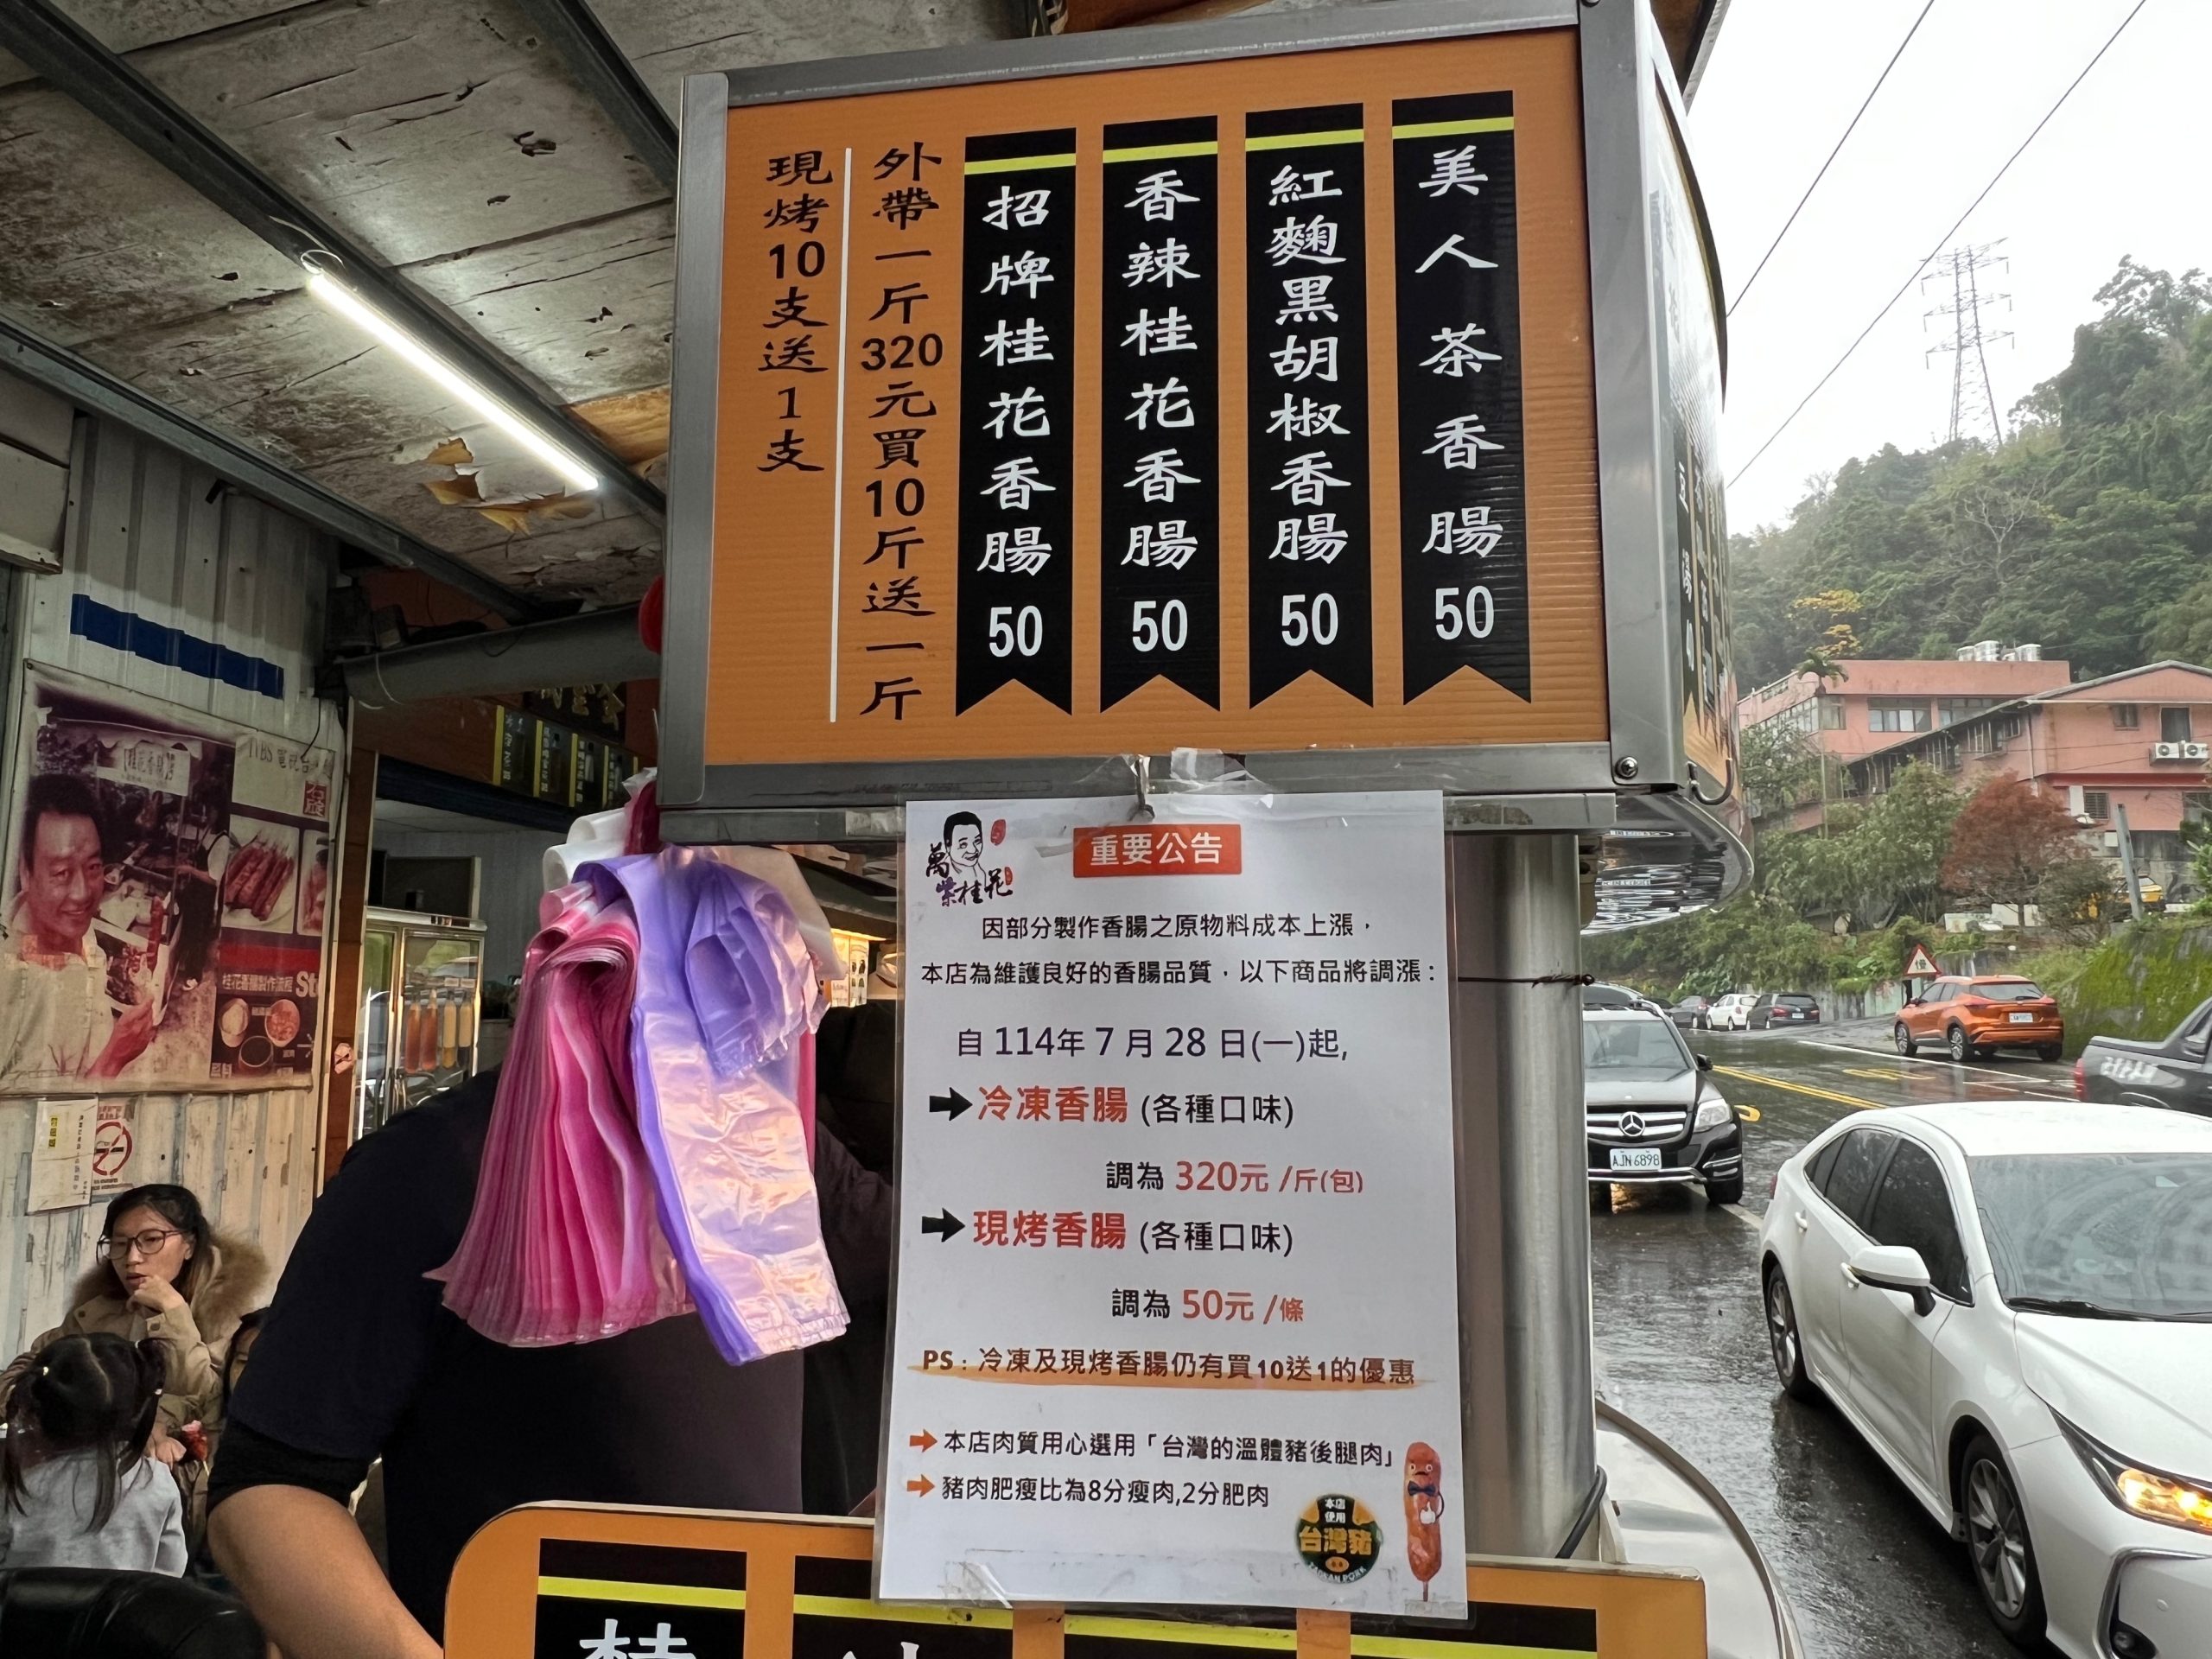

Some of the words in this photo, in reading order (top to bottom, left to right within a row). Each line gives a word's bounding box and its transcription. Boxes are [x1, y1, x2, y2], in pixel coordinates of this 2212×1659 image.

[757, 150, 834, 472] 現烤10支送1支
[1120, 169, 1201, 570] 香辣桂花香腸
[1265, 165, 1351, 564] 紅麴黑胡椒香腸
[1414, 144, 1505, 557] 美人茶香腸
[976, 185, 1056, 576] 招牌桂花香腸
[859, 142, 944, 721] 外帶一斤320元買10斤送一斤
[988, 606, 1044, 658] 50
[1132, 599, 1188, 652] 50
[1281, 593, 1338, 646] 50
[1435, 585, 1495, 640] 50
[1090, 831, 1223, 866] 重要公告
[957, 1028, 983, 1057] 自
[995, 1027, 1085, 1057] 114年
[1096, 1027, 1114, 1056] 7
[1126, 1029, 1153, 1058] 月
[1165, 1027, 1206, 1057] 28
[977, 1085, 1128, 1123] 冷凍香腸
[1141, 1094, 1294, 1128] (各種口味)
[1105, 1160, 1164, 1191] 調為
[1174, 1160, 1269, 1192] 320元
[972, 1210, 1126, 1249] 現烤香腸
[1139, 1221, 1294, 1257] (各種口味)
[1111, 1288, 1171, 1319] 調為
[1182, 1288, 1254, 1322] 50元
